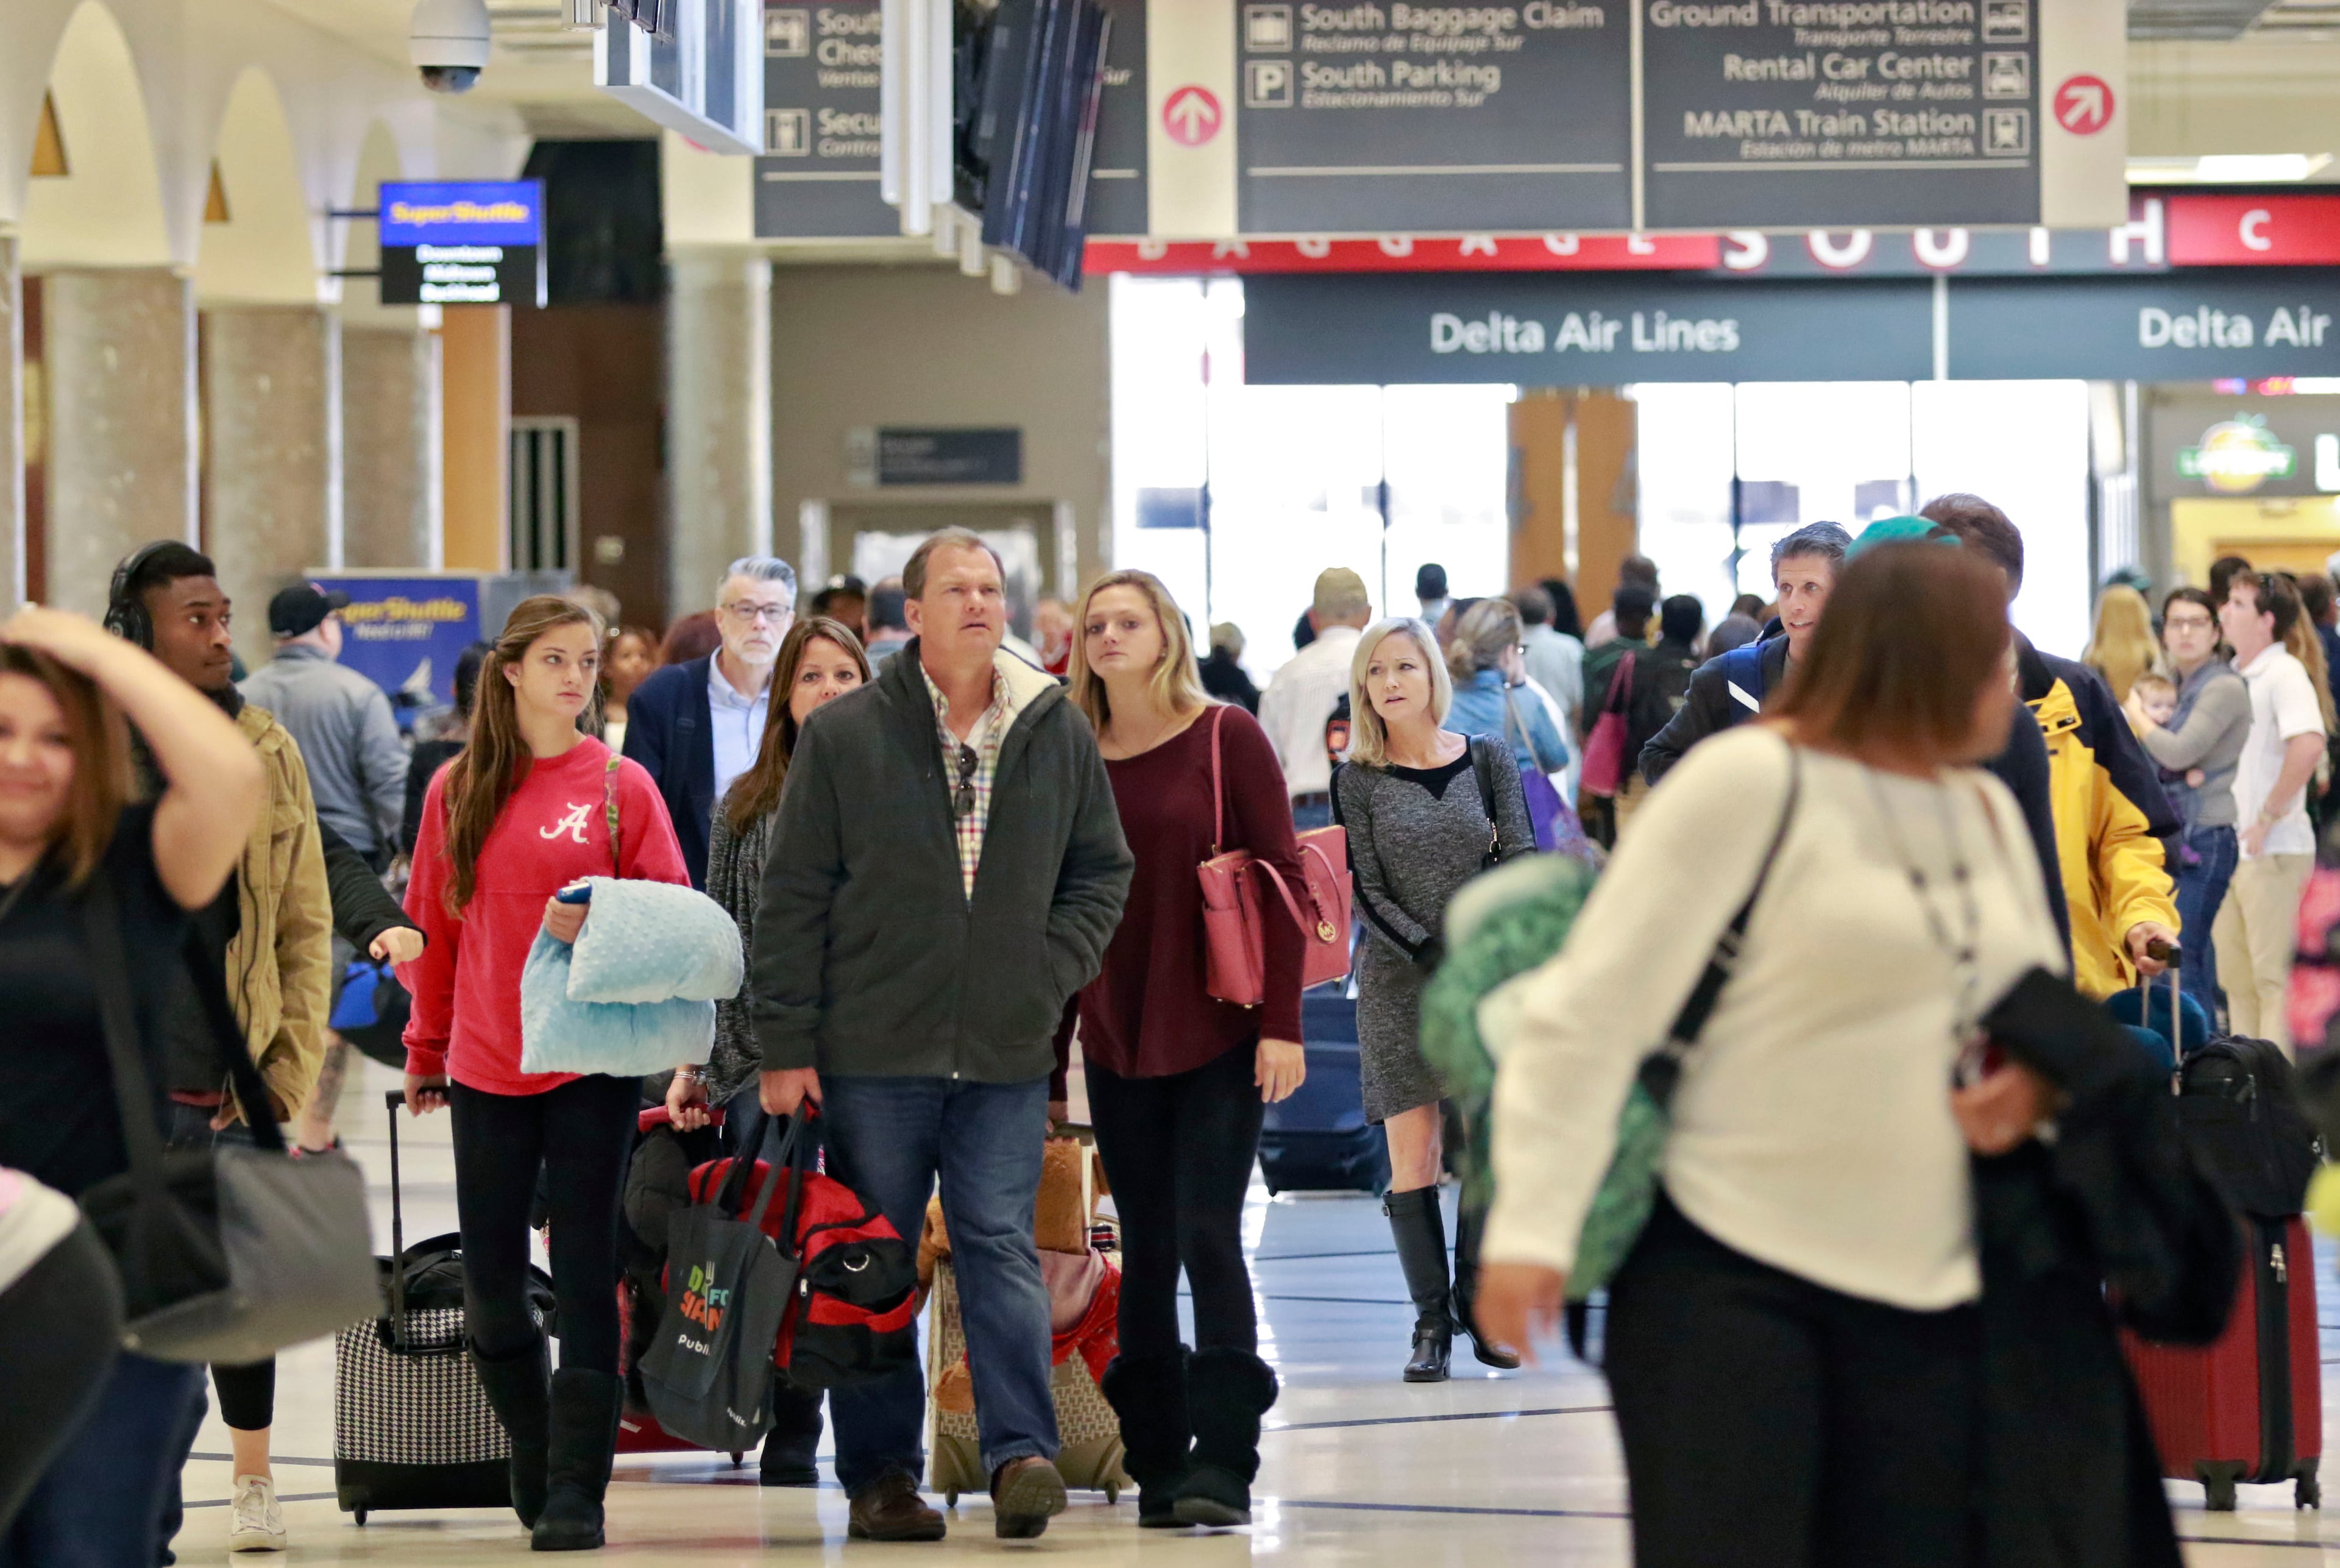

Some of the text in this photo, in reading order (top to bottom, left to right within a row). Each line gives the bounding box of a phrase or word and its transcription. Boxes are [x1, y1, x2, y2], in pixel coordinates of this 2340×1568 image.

[1300, 1, 1605, 36] South Baggage Claim
[1650, 0, 1976, 29] Ground Transportation
[1381, 32, 1408, 52] de
[1301, 59, 1501, 93] South Parking
[1723, 51, 1974, 81] Rental Car Center
[1890, 80, 1917, 101] de
[1684, 107, 1976, 138] MARTA Train Station
[1431, 310, 1740, 353] Delta Air Lines
[2138, 305, 2332, 348] Delta Air
[678, 1333, 711, 1356] Publi
